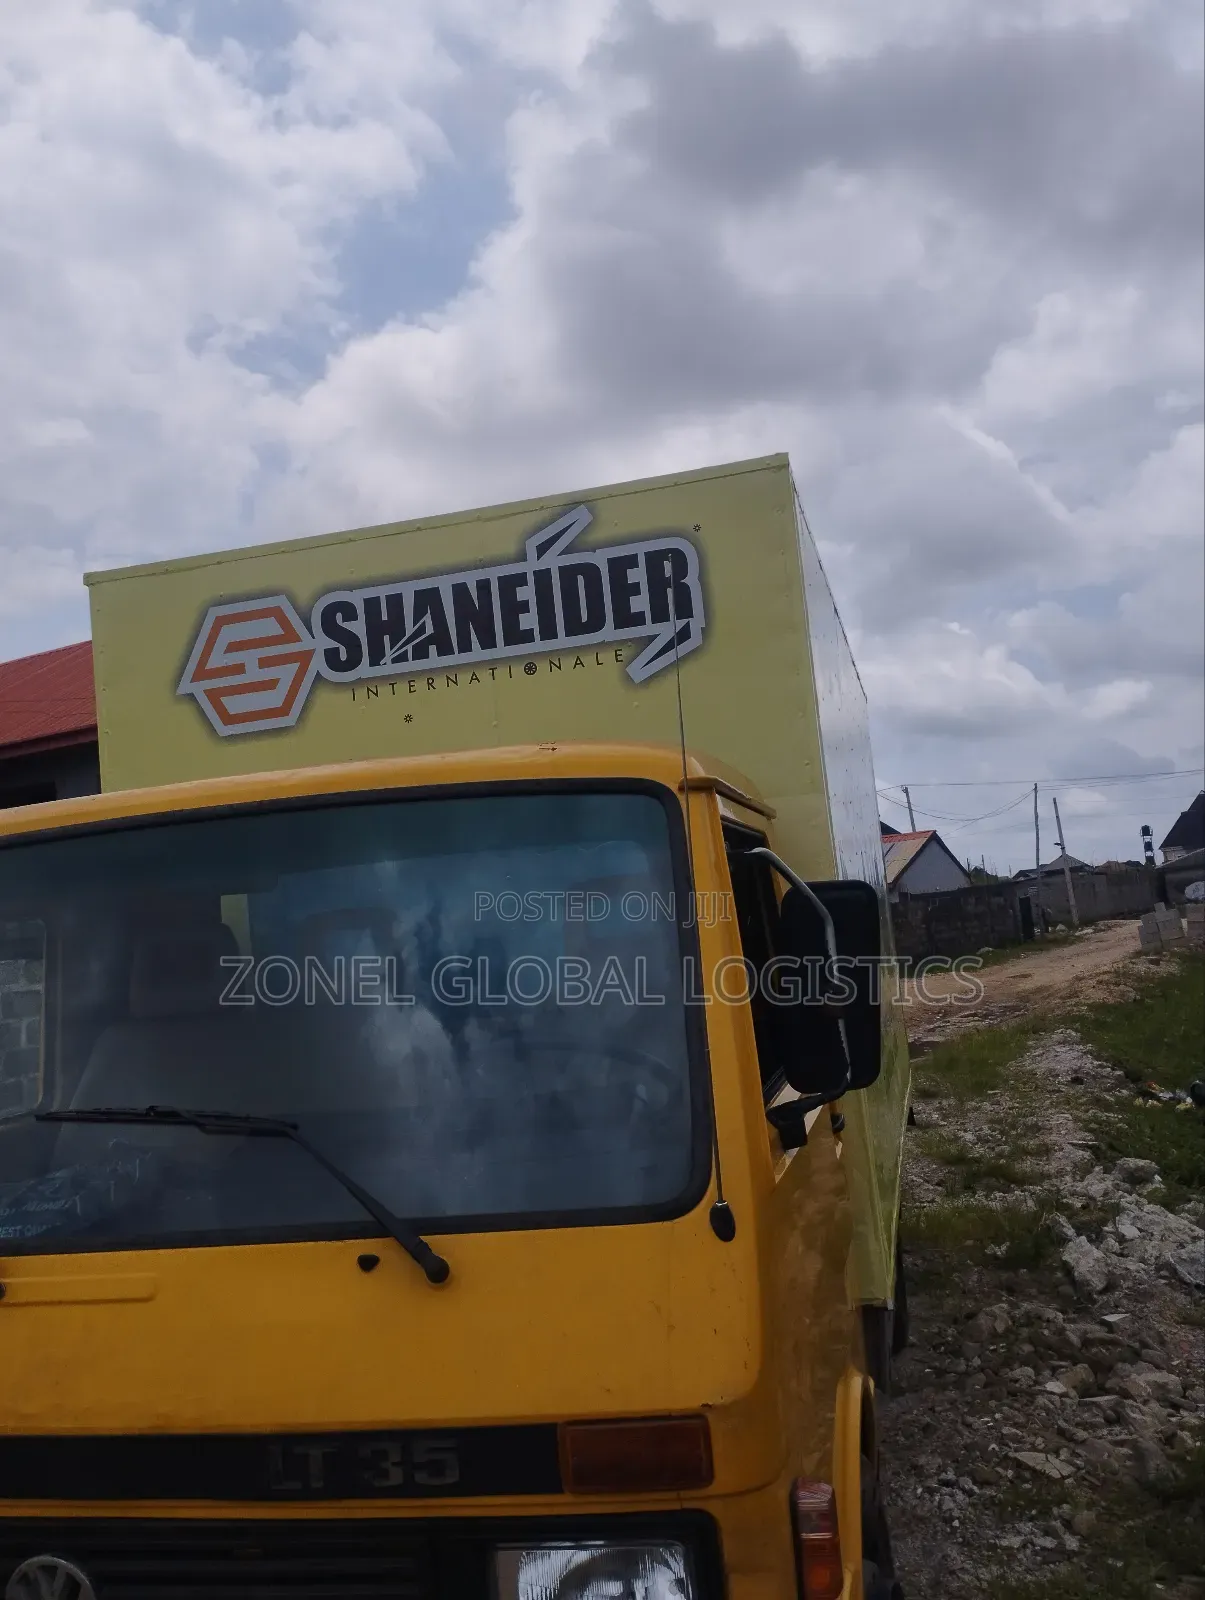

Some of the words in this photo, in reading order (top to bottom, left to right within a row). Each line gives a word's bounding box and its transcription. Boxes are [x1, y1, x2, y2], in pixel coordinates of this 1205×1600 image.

[319, 546, 694, 673] SHANEIDER
[351, 649, 625, 701] INTERNATIONALE
[267, 1443, 340, 1489] LT
[359, 1438, 460, 1487] 35
